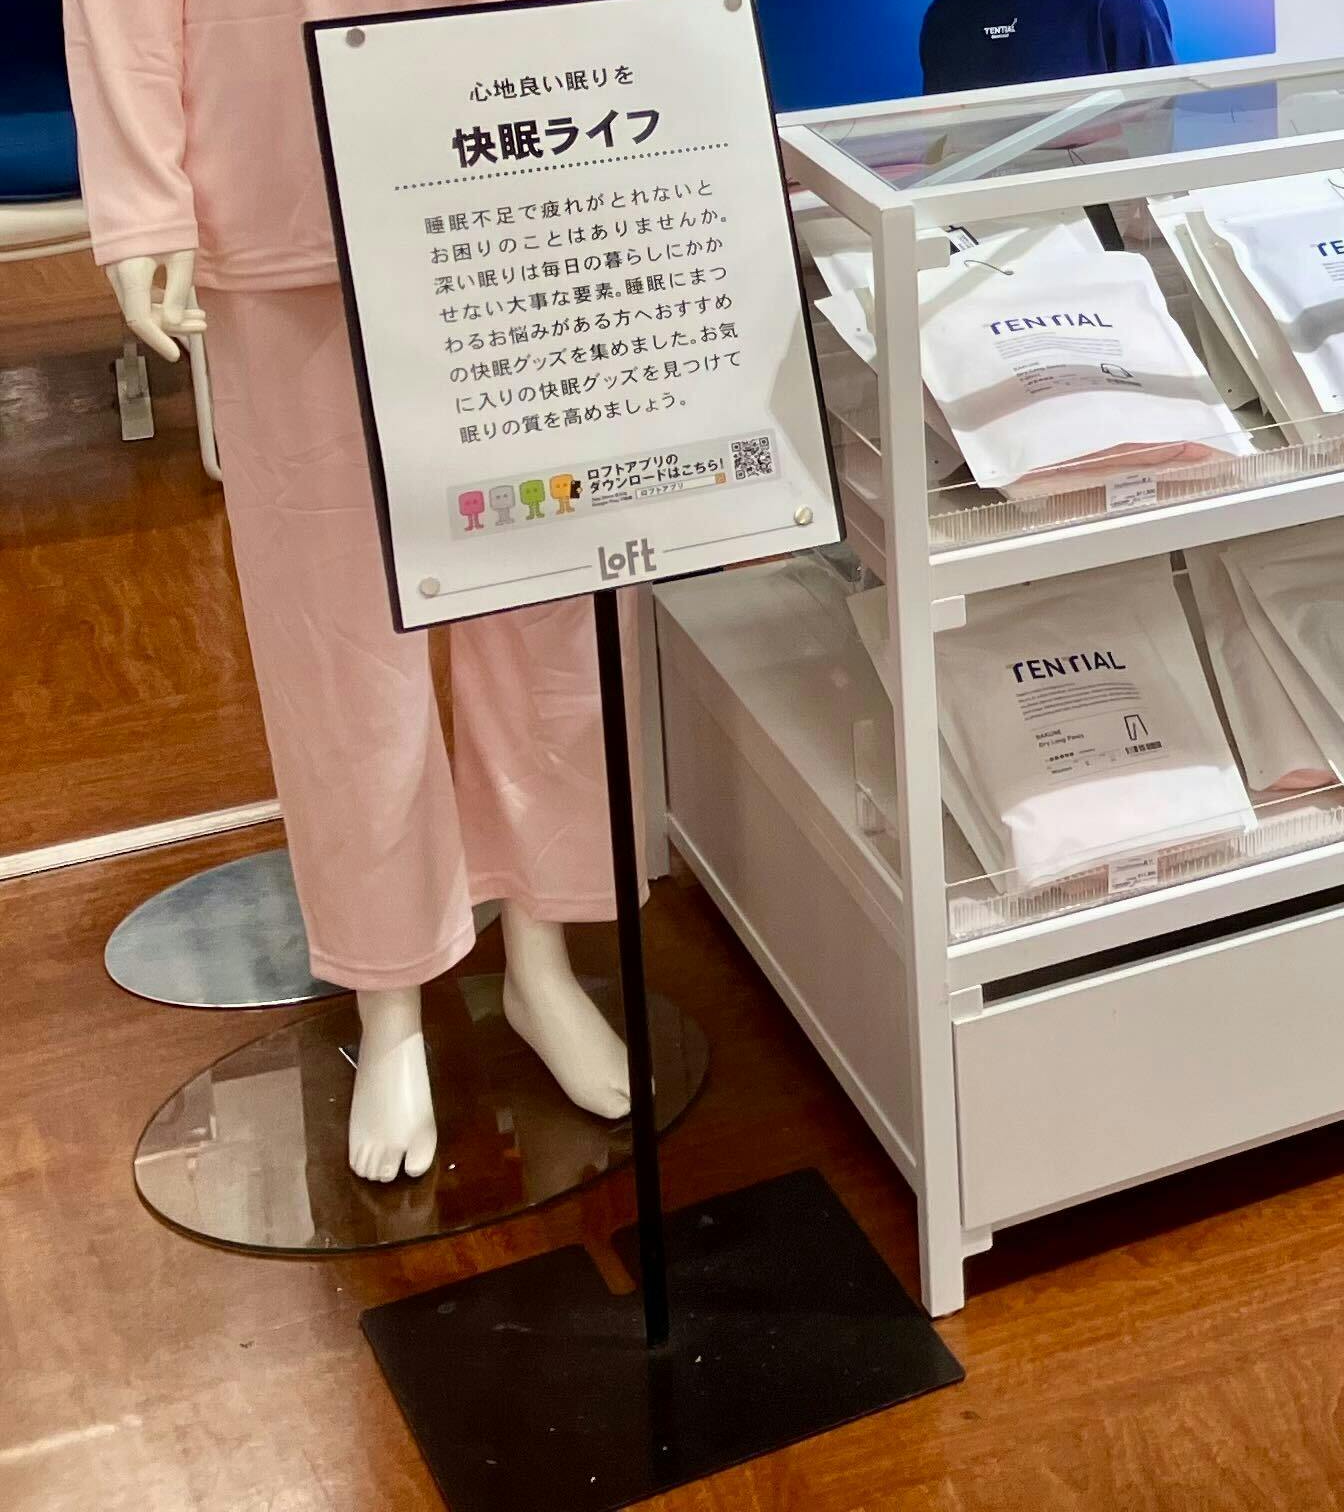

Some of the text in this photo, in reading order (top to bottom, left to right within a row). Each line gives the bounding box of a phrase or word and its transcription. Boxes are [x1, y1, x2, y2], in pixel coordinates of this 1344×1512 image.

[468, 64, 635, 104] 心地良い眠りを
[451, 108, 661, 169] 快眠ライフ
[423, 179, 715, 237] 睡眠不足で疲れがとれないと
[429, 207, 729, 266] お困りのことはありませんか。
[433, 235, 725, 297] 深い眠りは毎日の暮らしにかか
[438, 264, 729, 325] せない大事な要素。睡眠にまつ
[444, 293, 734, 355] わるお悩みがある方へおすすめ
[449, 321, 740, 384] の快眠グッズを集めました。お気
[986, 312, 1114, 336] TENTIAL
[454, 350, 744, 414] に入りの快眠グッズを見つけて
[459, 393, 690, 444] 眠りの質を高めましょう。
[587, 453, 679, 481] ロフトアプリの
[589, 457, 726, 494] ダウンロードはこちら!
[640, 482, 684, 497] ロフトアプリ
[1006, 650, 1127, 684] TENTIAL
